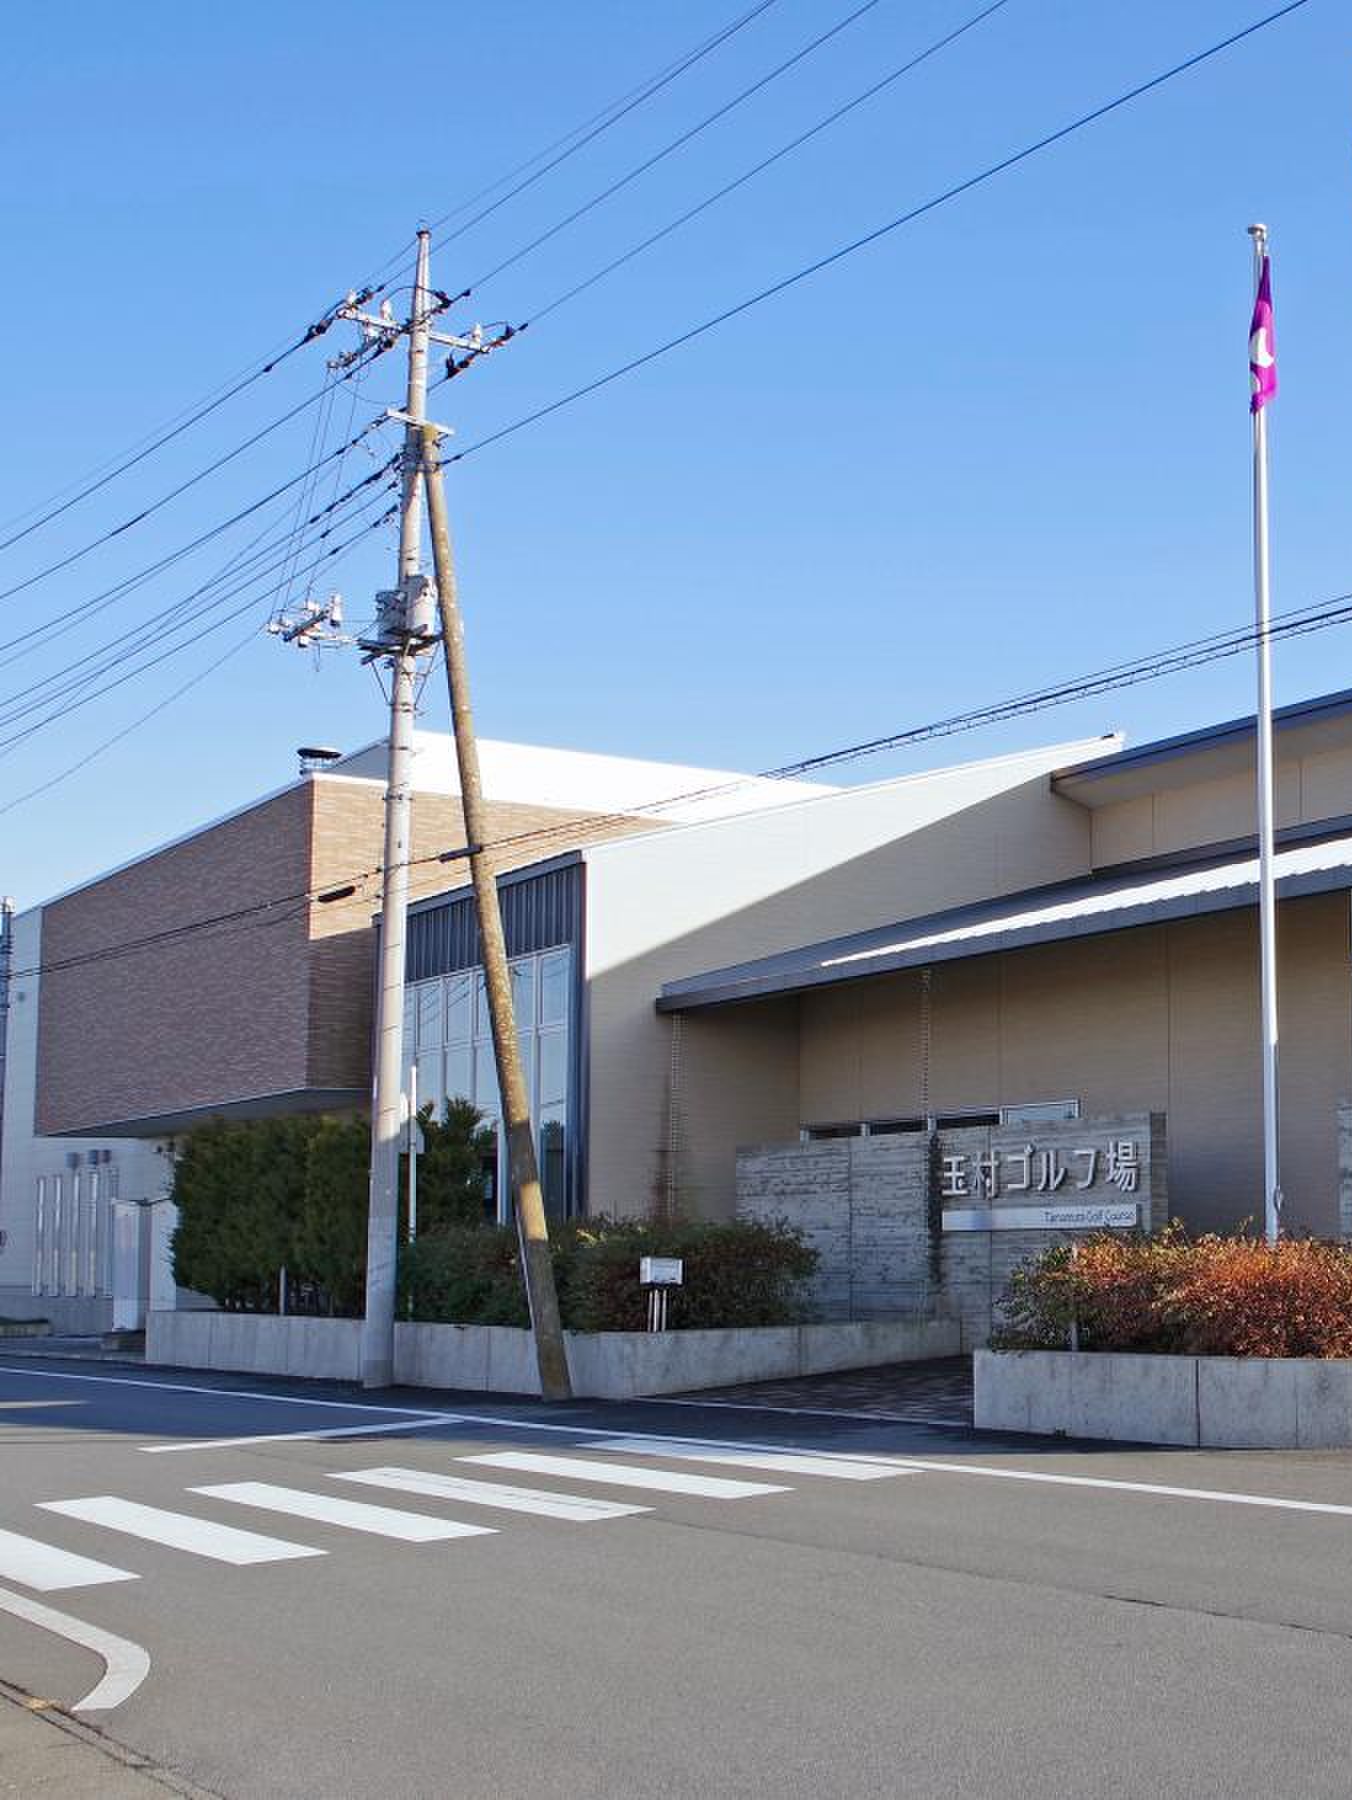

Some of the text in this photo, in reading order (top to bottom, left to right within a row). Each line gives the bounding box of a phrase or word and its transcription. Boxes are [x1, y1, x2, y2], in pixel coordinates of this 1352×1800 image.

[942, 1140, 1139, 1199] 玉村ゴルフ場
